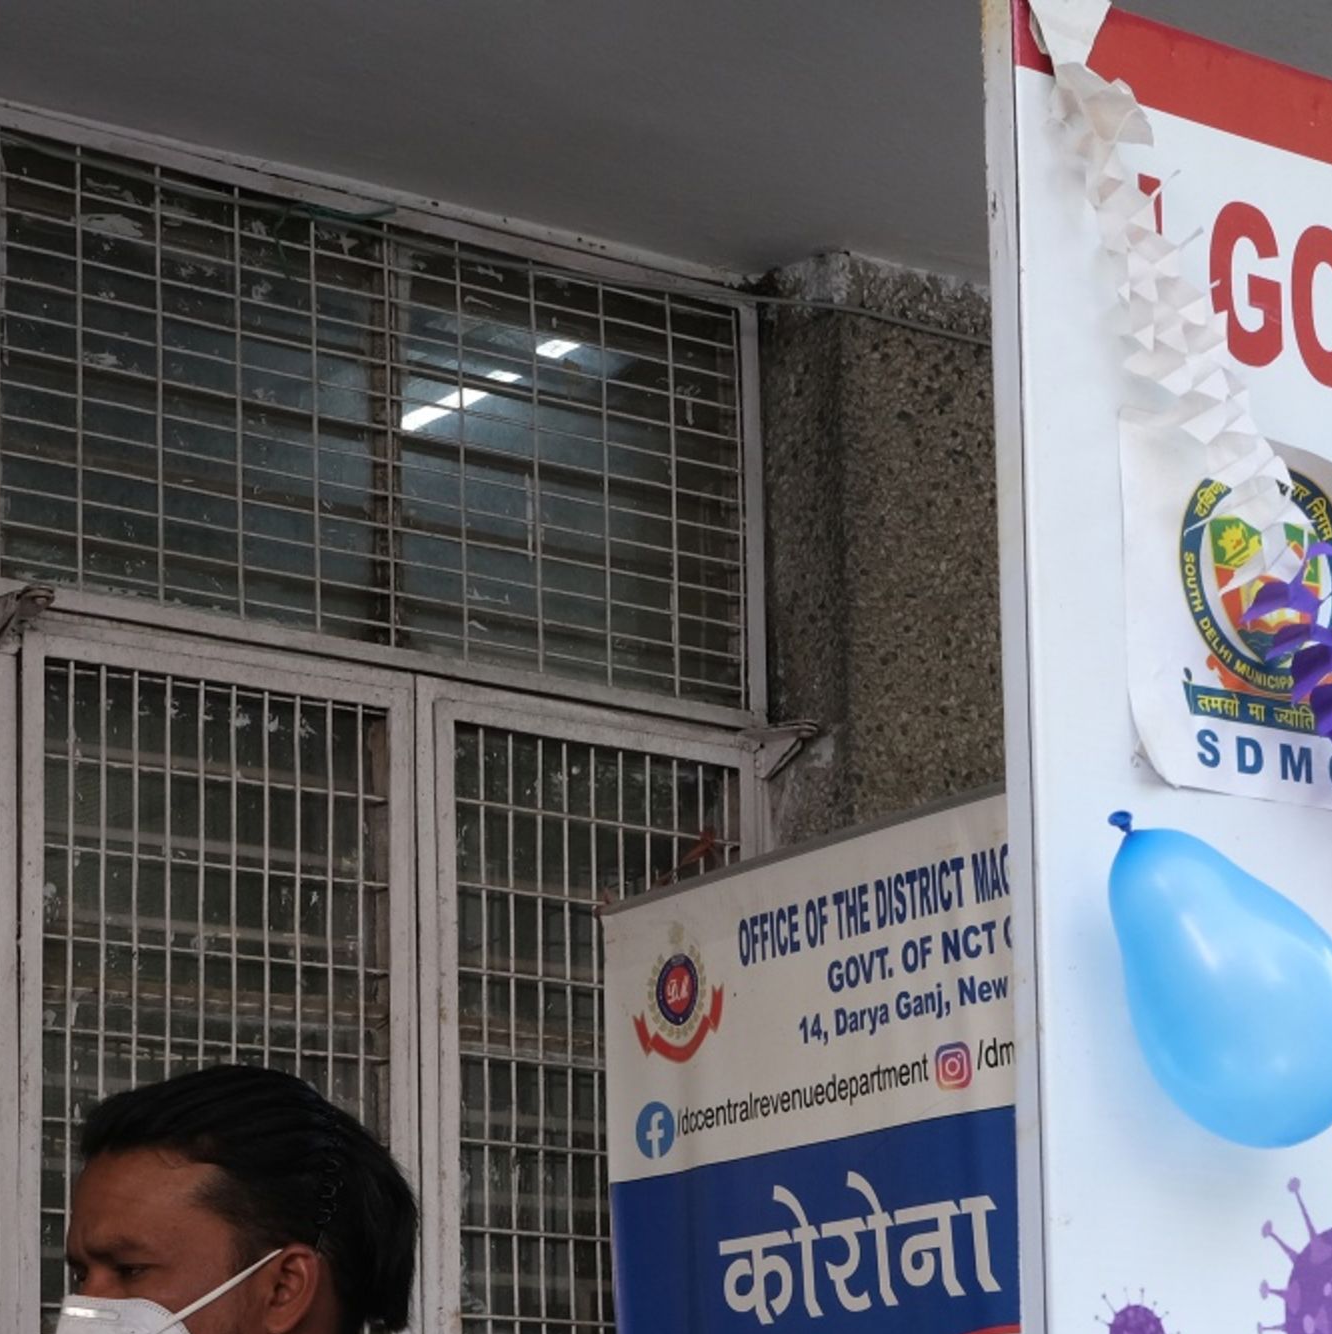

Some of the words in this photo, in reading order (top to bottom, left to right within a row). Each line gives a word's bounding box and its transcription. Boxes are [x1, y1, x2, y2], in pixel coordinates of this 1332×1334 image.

[1184, 551, 1204, 614] SOUTH
[1198, 617, 1233, 665] DELHI
[1197, 694, 1240, 720] तमसो
[1248, 702, 1265, 722] मा
[738, 903, 801, 967] OFFICE
[805, 894, 829, 949] OF
[832, 883, 871, 941] THE
[874, 857, 965, 930] DISTRICT
[827, 946, 894, 993] GOVT.
[901, 935, 933, 973] OF
[941, 920, 997, 964] NCT
[798, 1013, 829, 1046] 14,
[834, 1001, 888, 1037] Darya
[895, 982, 951, 1020] Ganj,
[957, 975, 1009, 1008] New
[719, 1170, 1002, 1326] कोरोना
